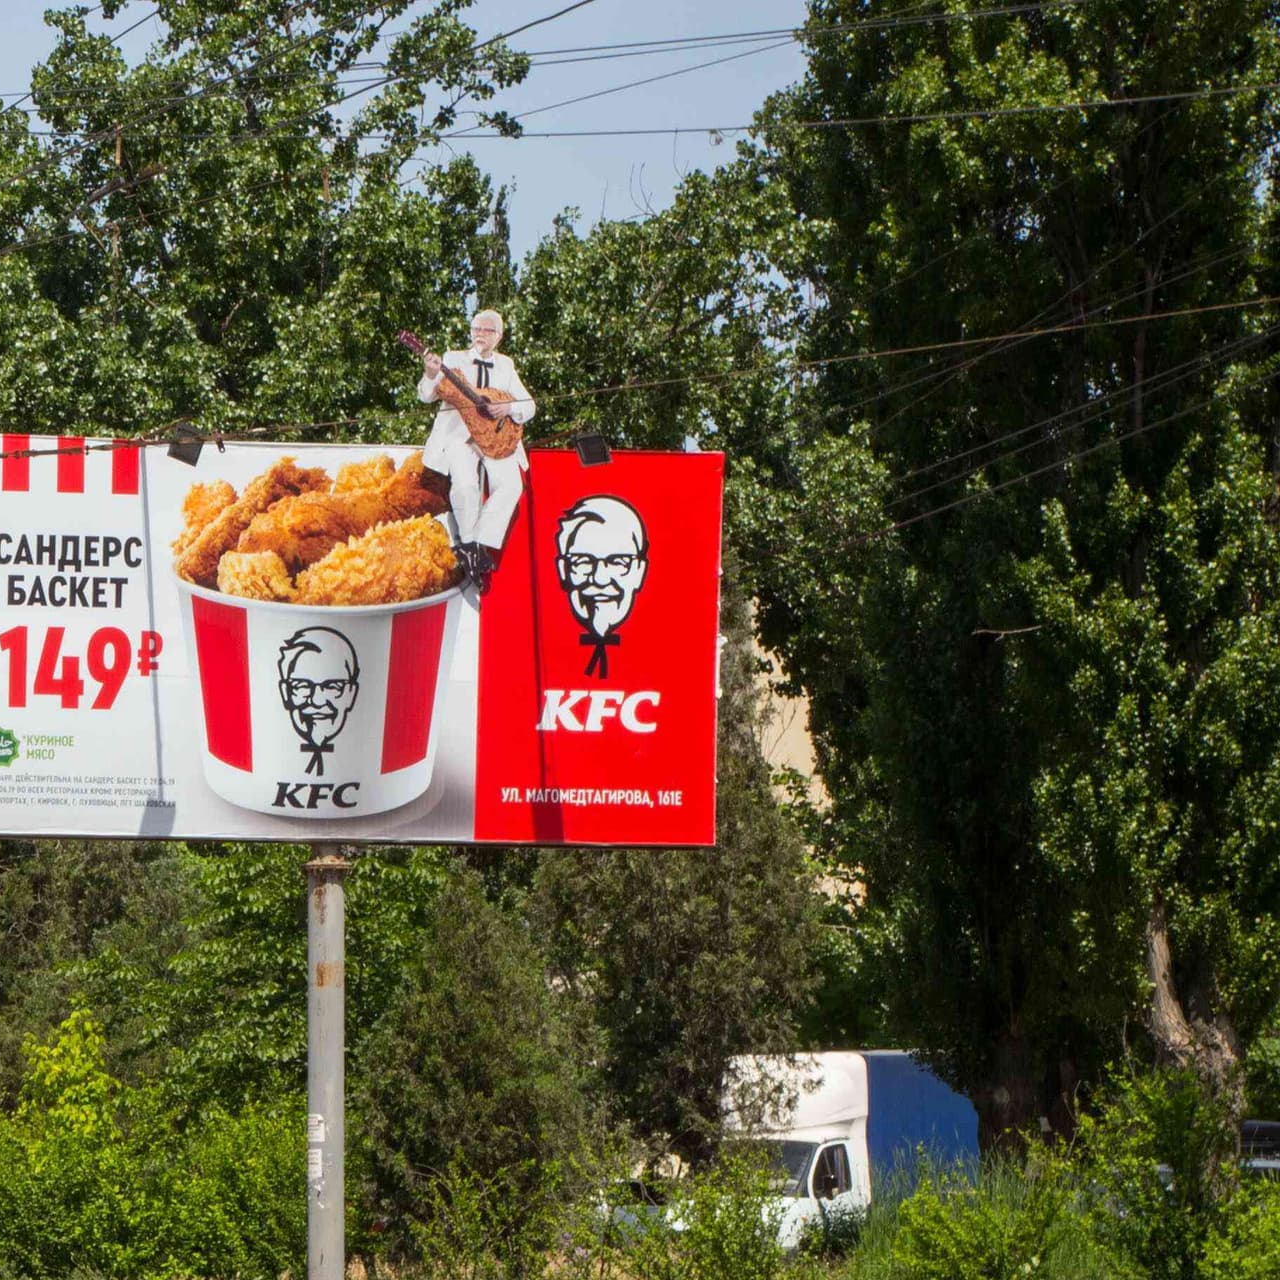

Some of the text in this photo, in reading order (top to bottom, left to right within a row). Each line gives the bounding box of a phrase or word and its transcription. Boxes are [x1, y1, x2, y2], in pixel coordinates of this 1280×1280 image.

[7, 575, 129, 609] БАСКЕТ
[536, 689, 661, 733] KFC
[26, 748, 55, 760] МЯСО
[84, 775, 114, 785] САНДЕРС
[271, 782, 360, 809] KFC
[501, 787, 522, 803] УЛ.
[526, 788, 654, 808] МАГОМЕДТАГИРОВА,
